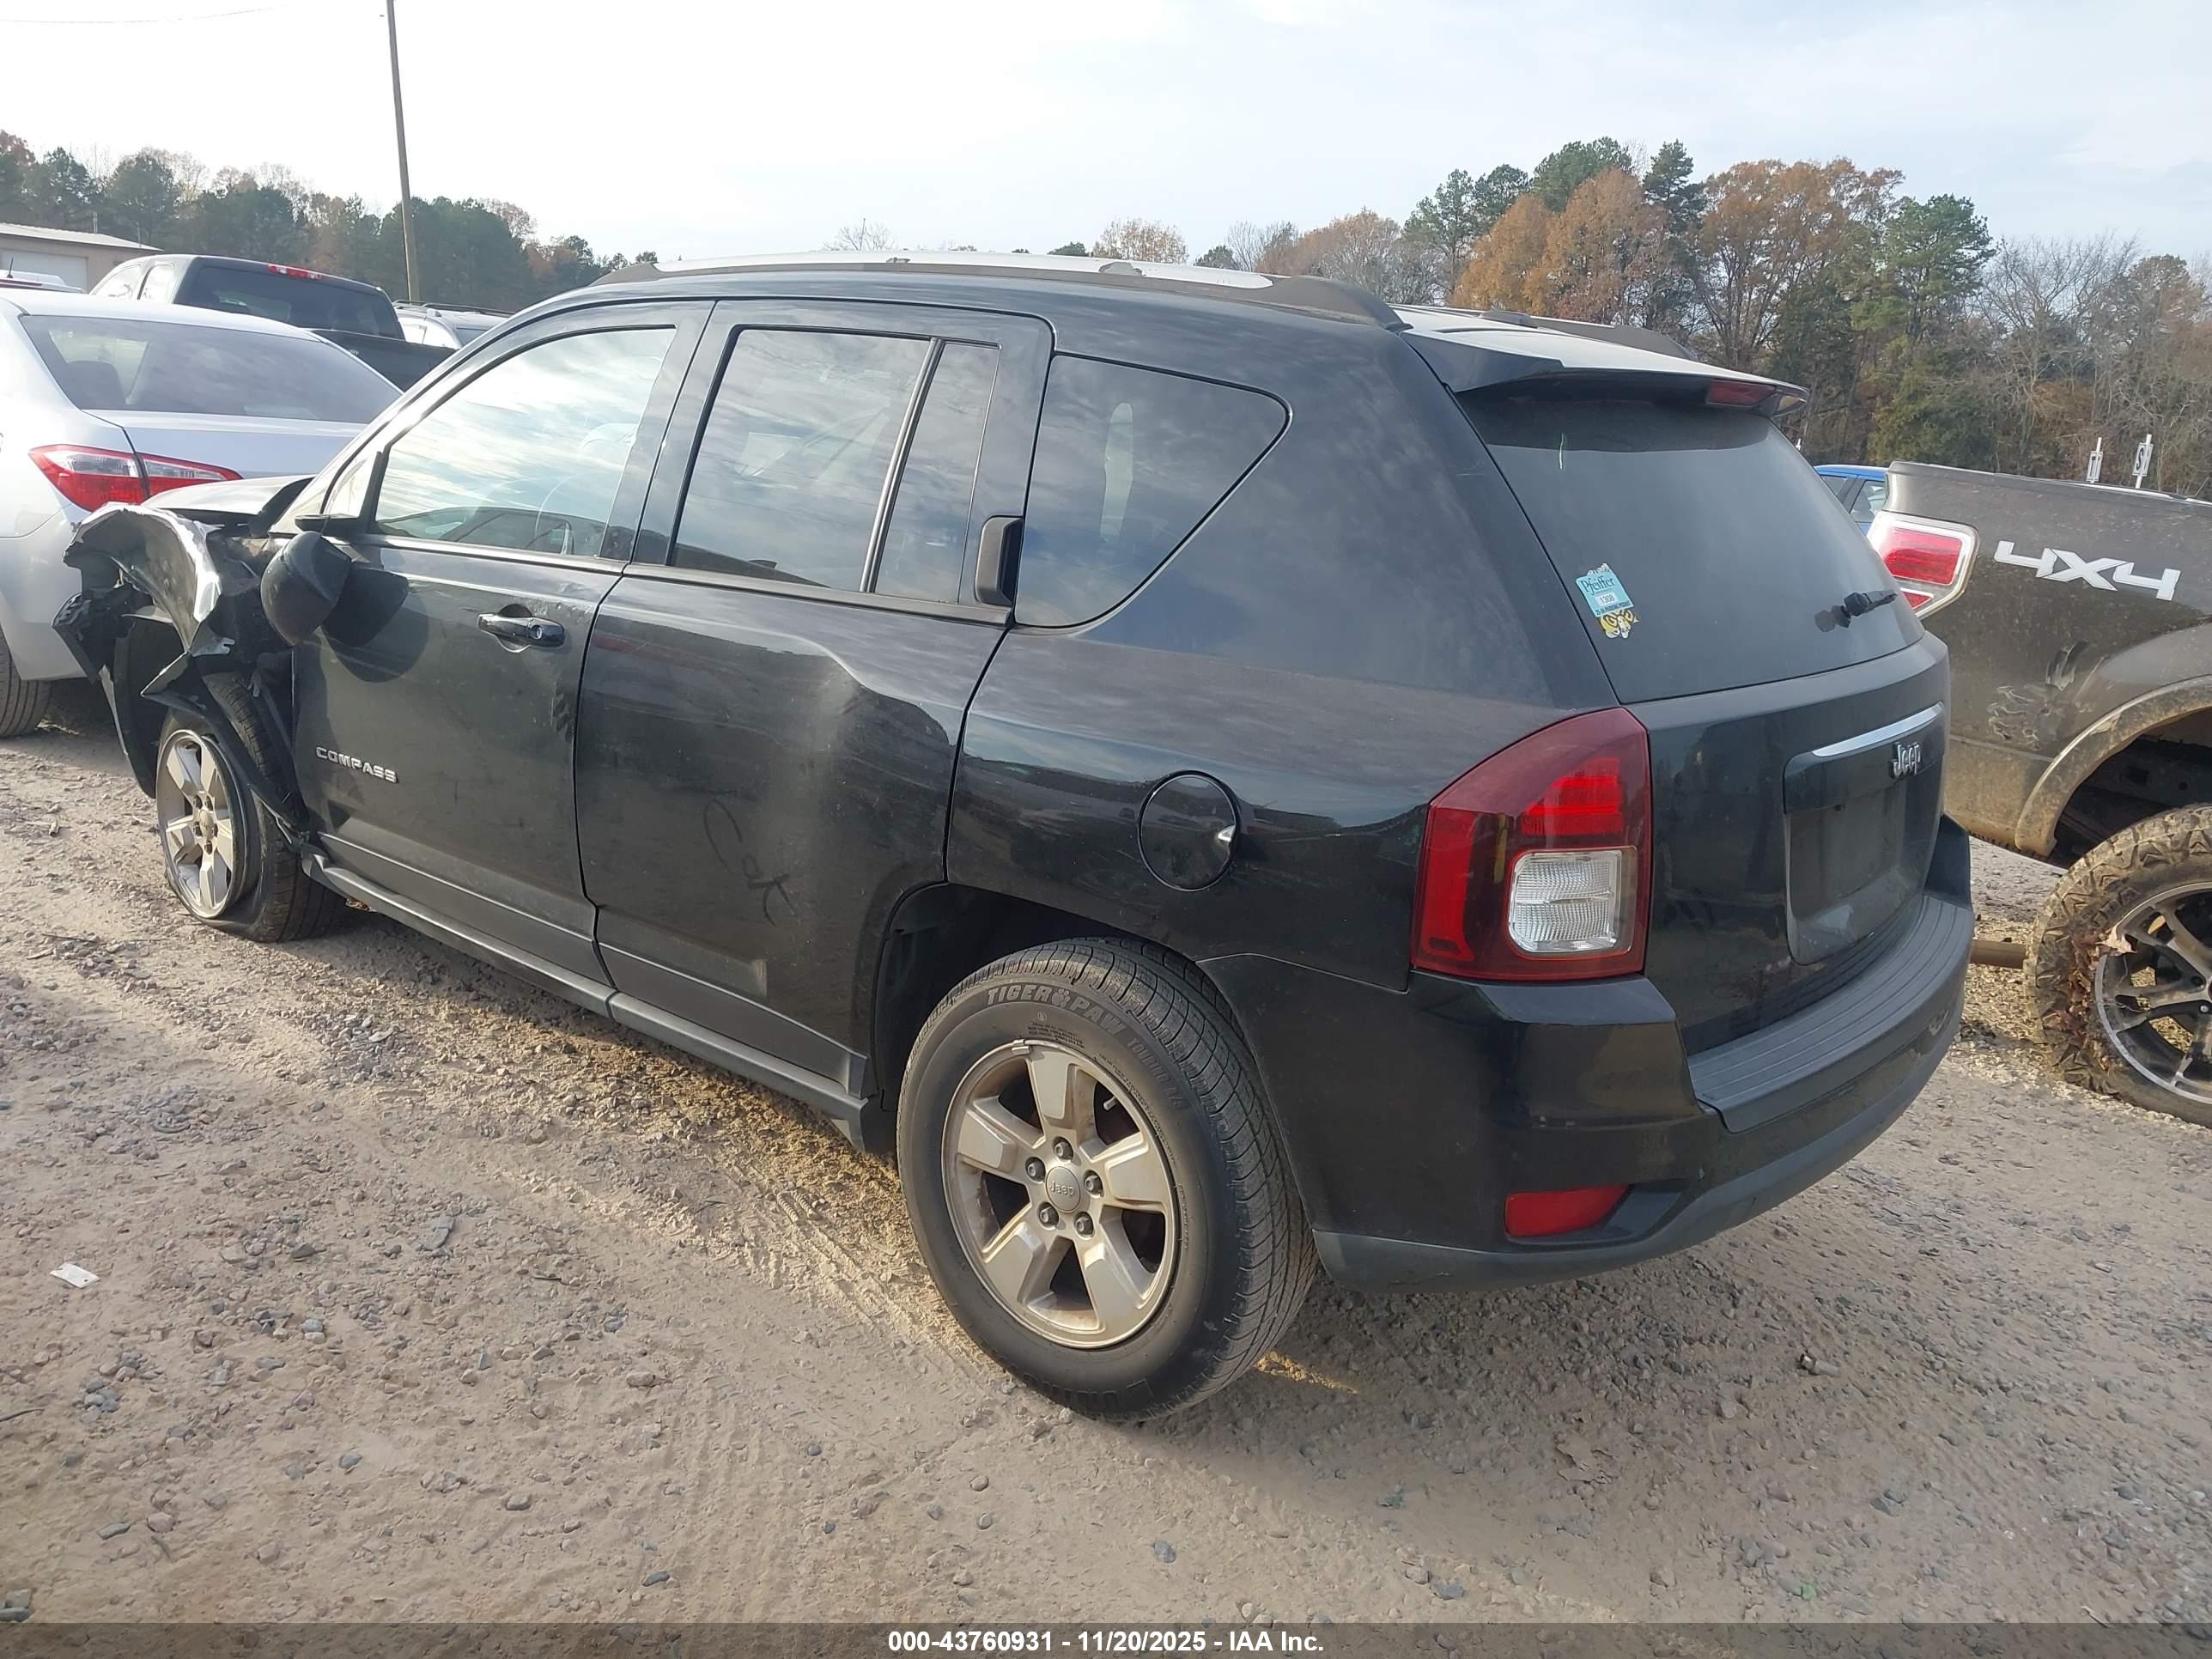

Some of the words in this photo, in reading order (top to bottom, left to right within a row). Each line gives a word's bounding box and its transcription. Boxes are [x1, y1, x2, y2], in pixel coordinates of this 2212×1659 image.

[1580, 576, 1615, 595] Pfeiffer
[316, 746, 398, 783] COMPASS
[1891, 742, 1922, 779] Jeep
[988, 986, 1054, 1006] TIGER
[1071, 998, 1124, 1035] PAW
[1049, 1181, 1075, 1199] Jeep
